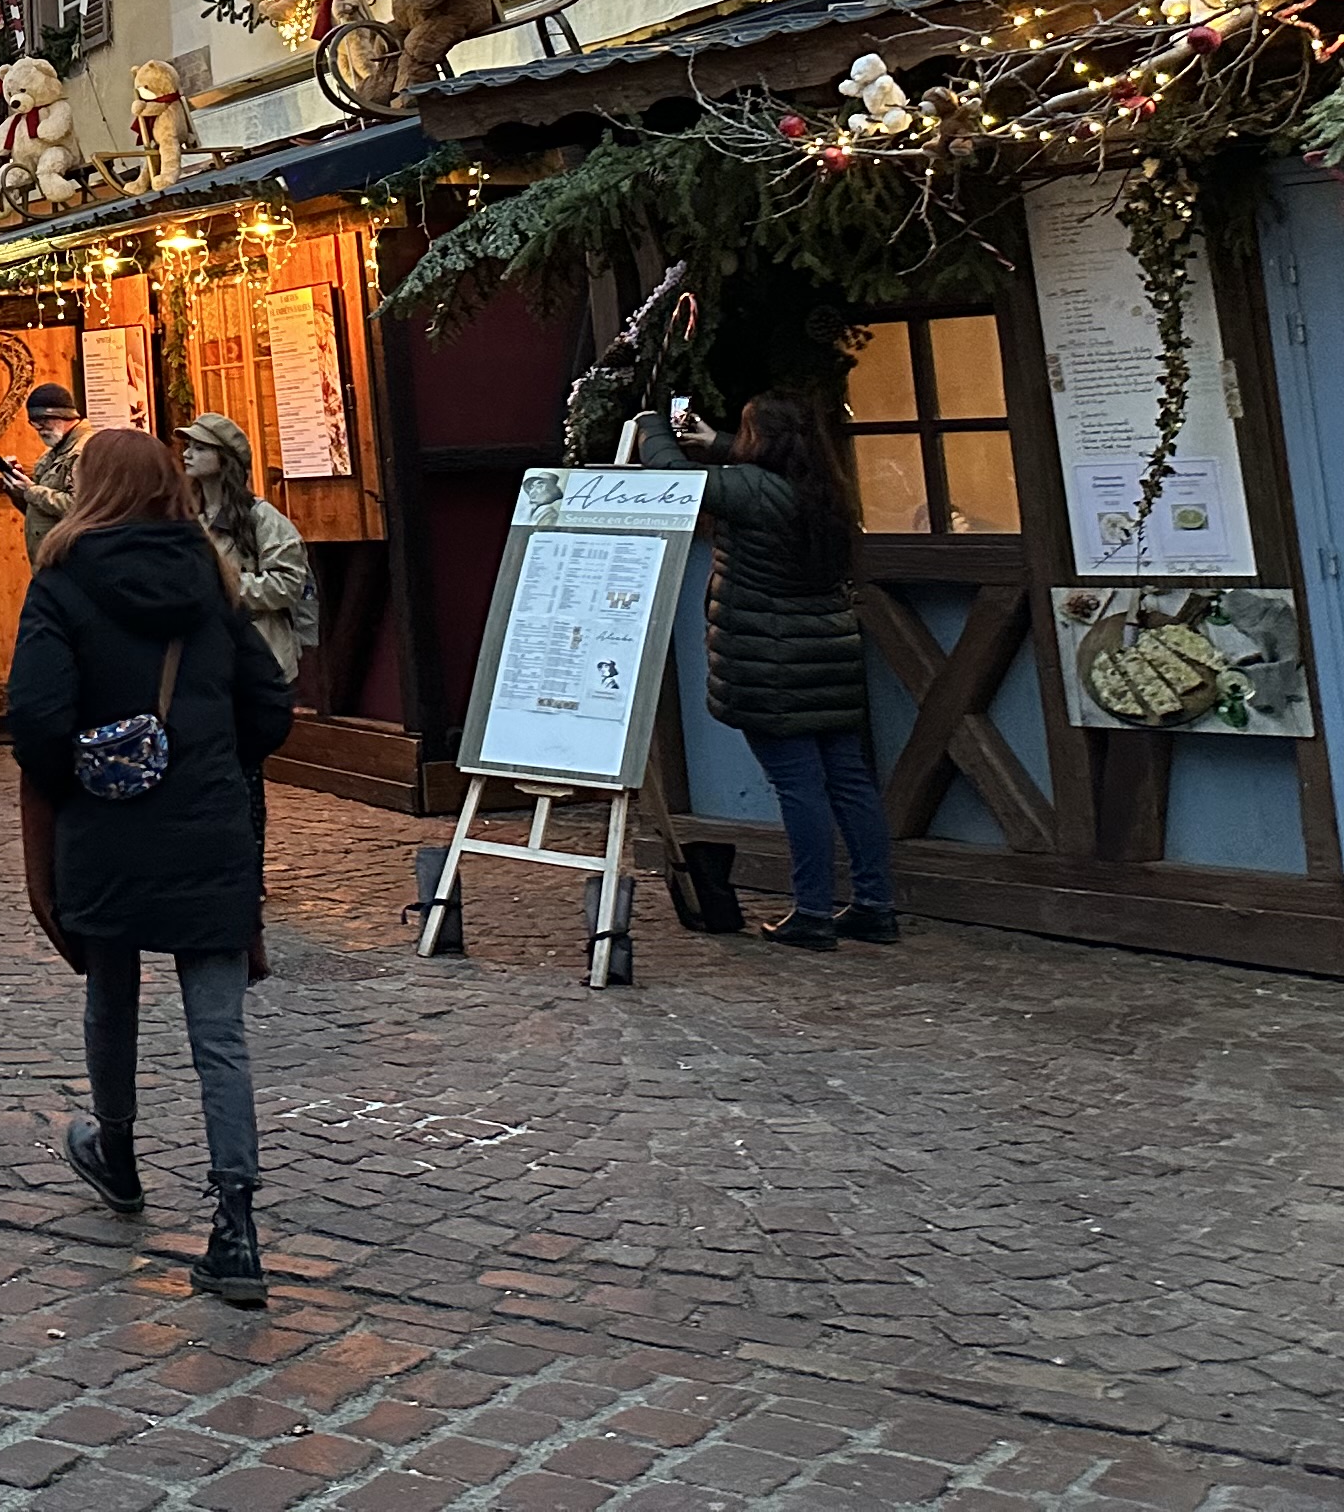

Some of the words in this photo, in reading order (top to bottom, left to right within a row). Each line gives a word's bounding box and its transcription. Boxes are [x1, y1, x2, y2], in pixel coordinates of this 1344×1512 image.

[565, 474, 699, 510] Alsako
[564, 513, 606, 525] Service
[607, 515, 621, 525] en
[623, 515, 669, 526] Continu
